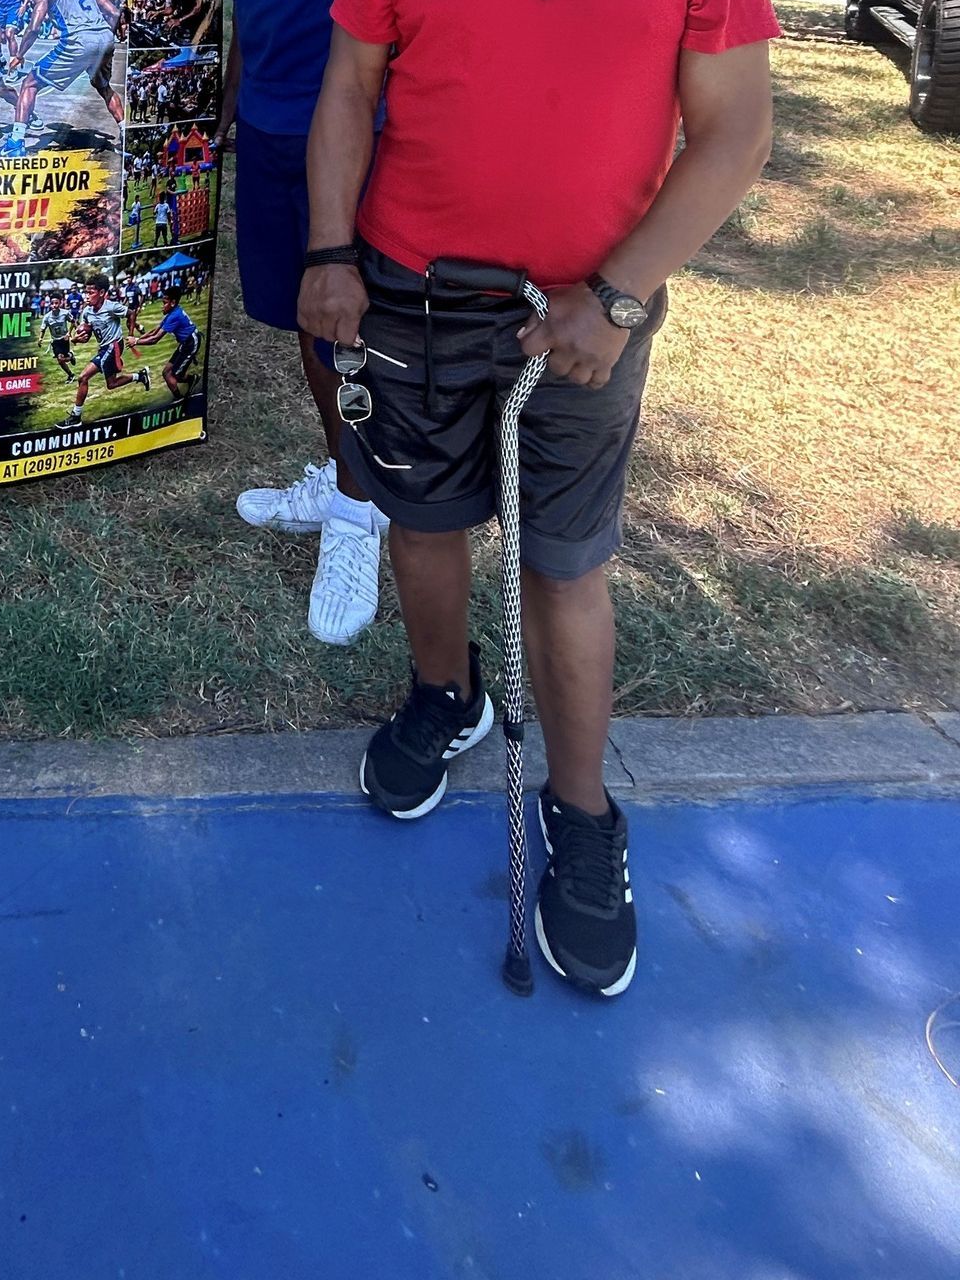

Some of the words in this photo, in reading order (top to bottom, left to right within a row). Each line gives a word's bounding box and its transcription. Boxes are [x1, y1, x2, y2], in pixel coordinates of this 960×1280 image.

[52, 157, 69, 169] BY
[21, 170, 90, 194] FLAVOR
[14, 272, 30, 288] TO
[6, 379, 31, 390] GAME
[11, 425, 118, 457] COMMUNITY.
[142, 405, 187, 430] UNITY.
[3, 463, 21, 479] AT
[23, 445, 115, 477] (209)735-9126
